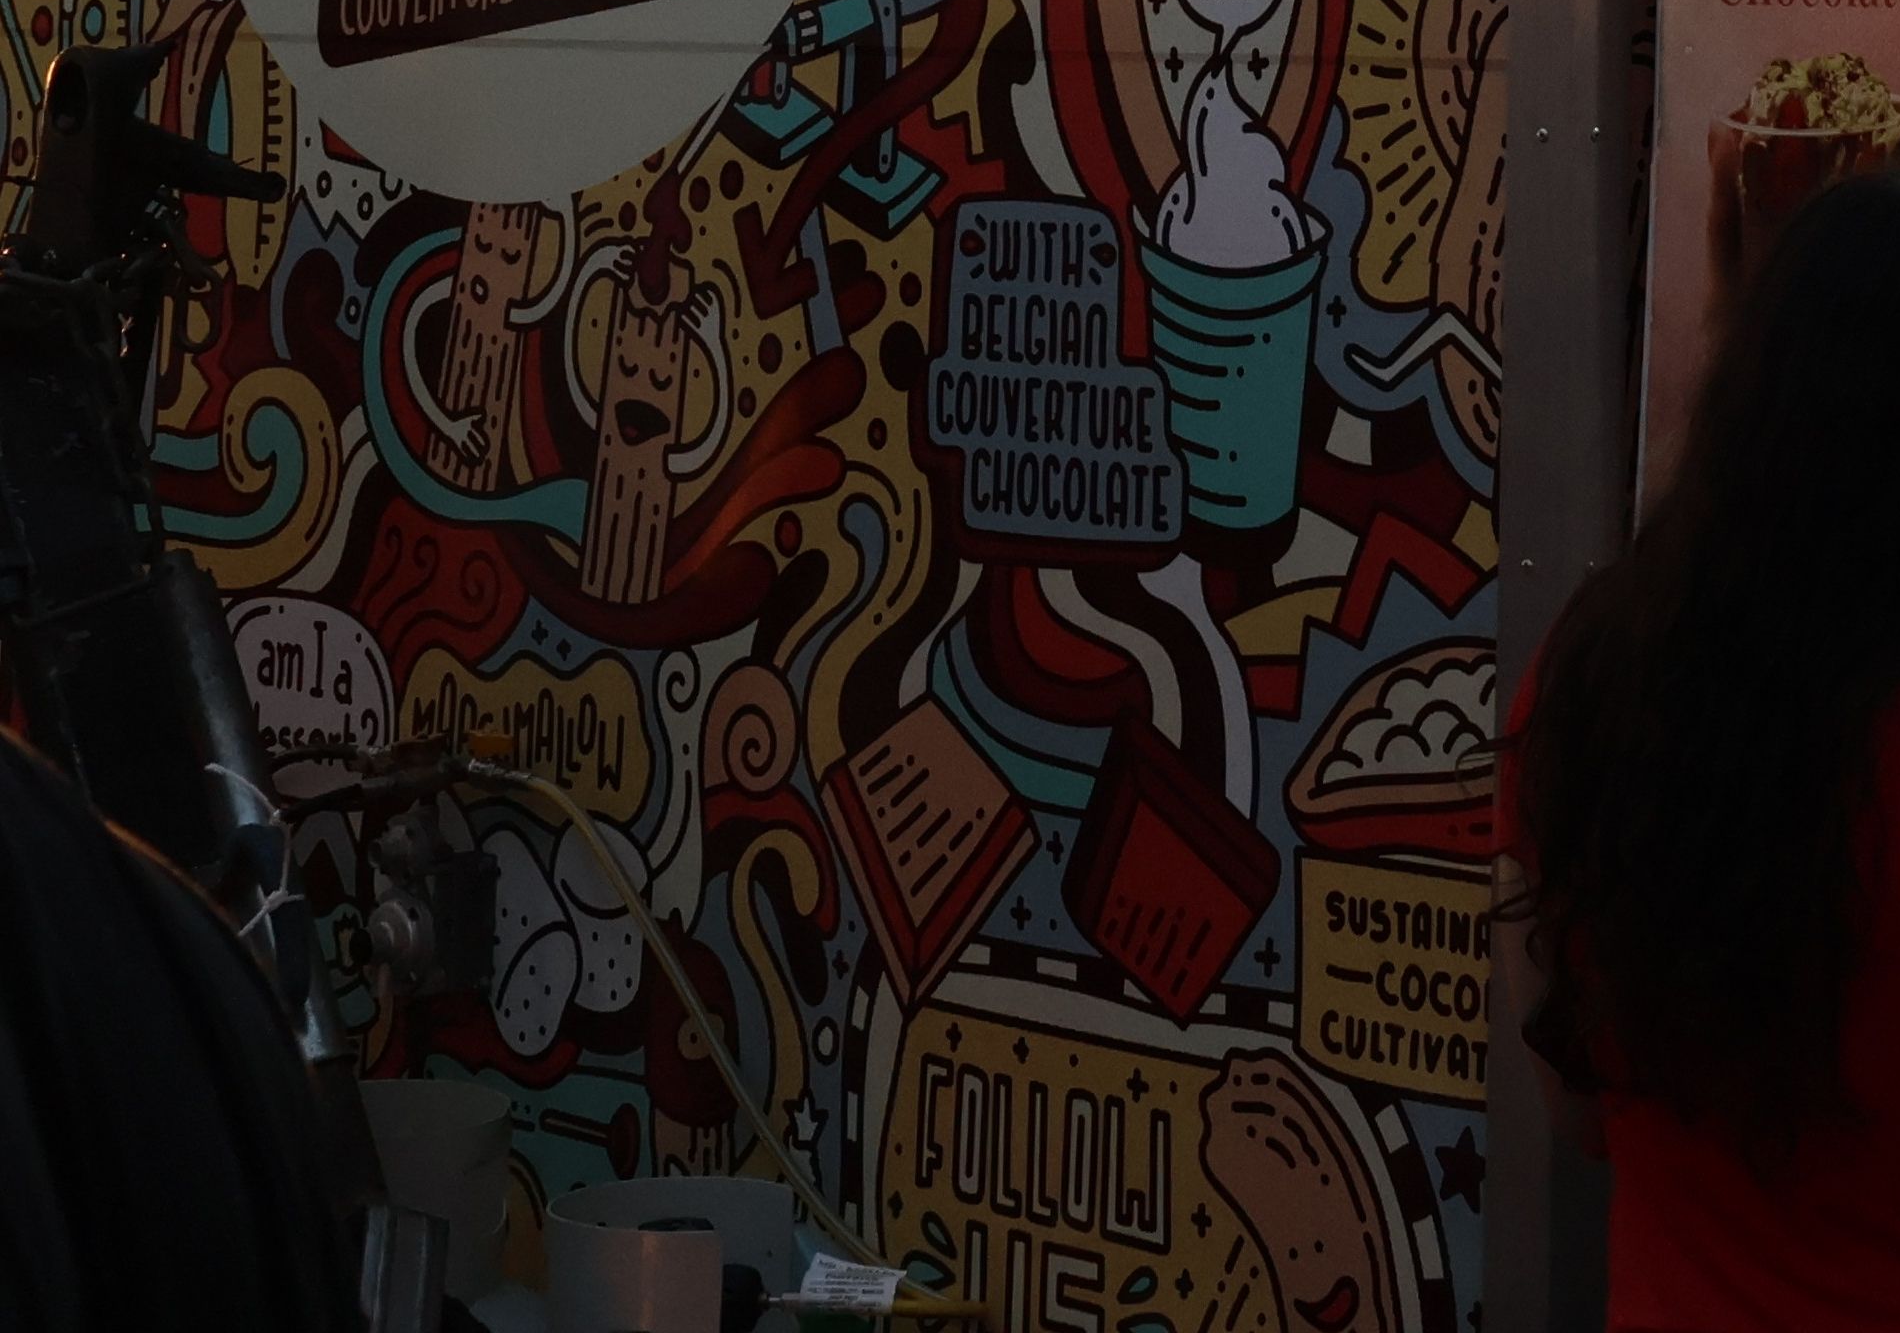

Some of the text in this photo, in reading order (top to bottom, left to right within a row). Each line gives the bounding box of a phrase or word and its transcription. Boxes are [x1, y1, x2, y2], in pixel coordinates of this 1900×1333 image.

[985, 220, 1084, 289] WITH
[960, 293, 1108, 370] BELGIAN
[935, 370, 1156, 456] COUVERTURE
[970, 446, 1173, 533] CHOCOLATE
[257, 620, 353, 706] am I a
[1376, 960, 1490, 1024] COCO
[915, 1052, 1172, 1256] FOLLOW
